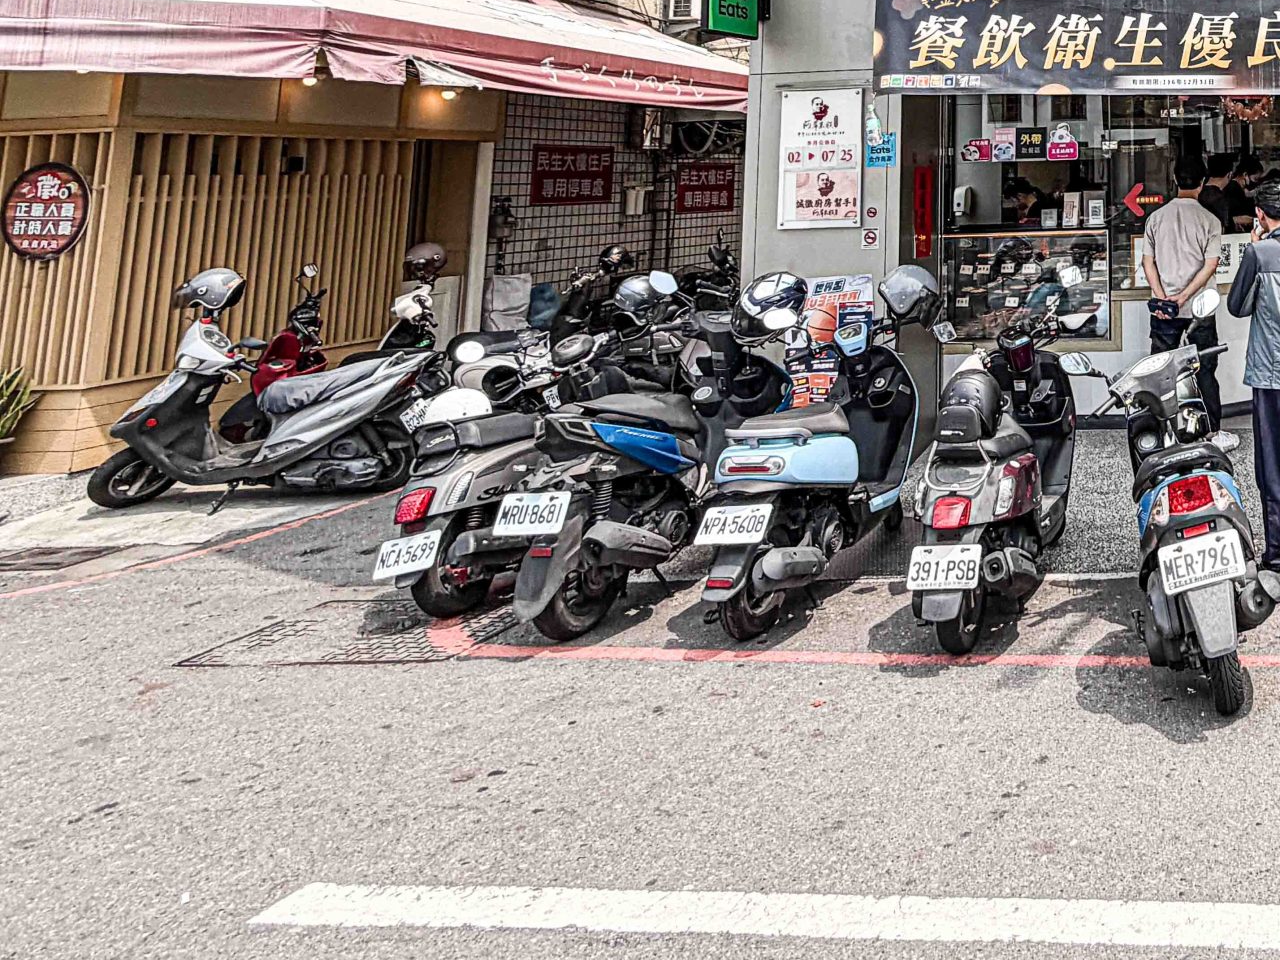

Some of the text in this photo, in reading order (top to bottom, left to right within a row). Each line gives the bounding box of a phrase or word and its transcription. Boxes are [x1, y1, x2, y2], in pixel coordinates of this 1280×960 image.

[1021, 133, 1042, 144] 外帶
[788, 149, 853, 163] 02 07 25
[870, 146, 891, 155] Eats
[15, 202, 76, 217] 正職人員
[12, 221, 73, 236] 計時人員
